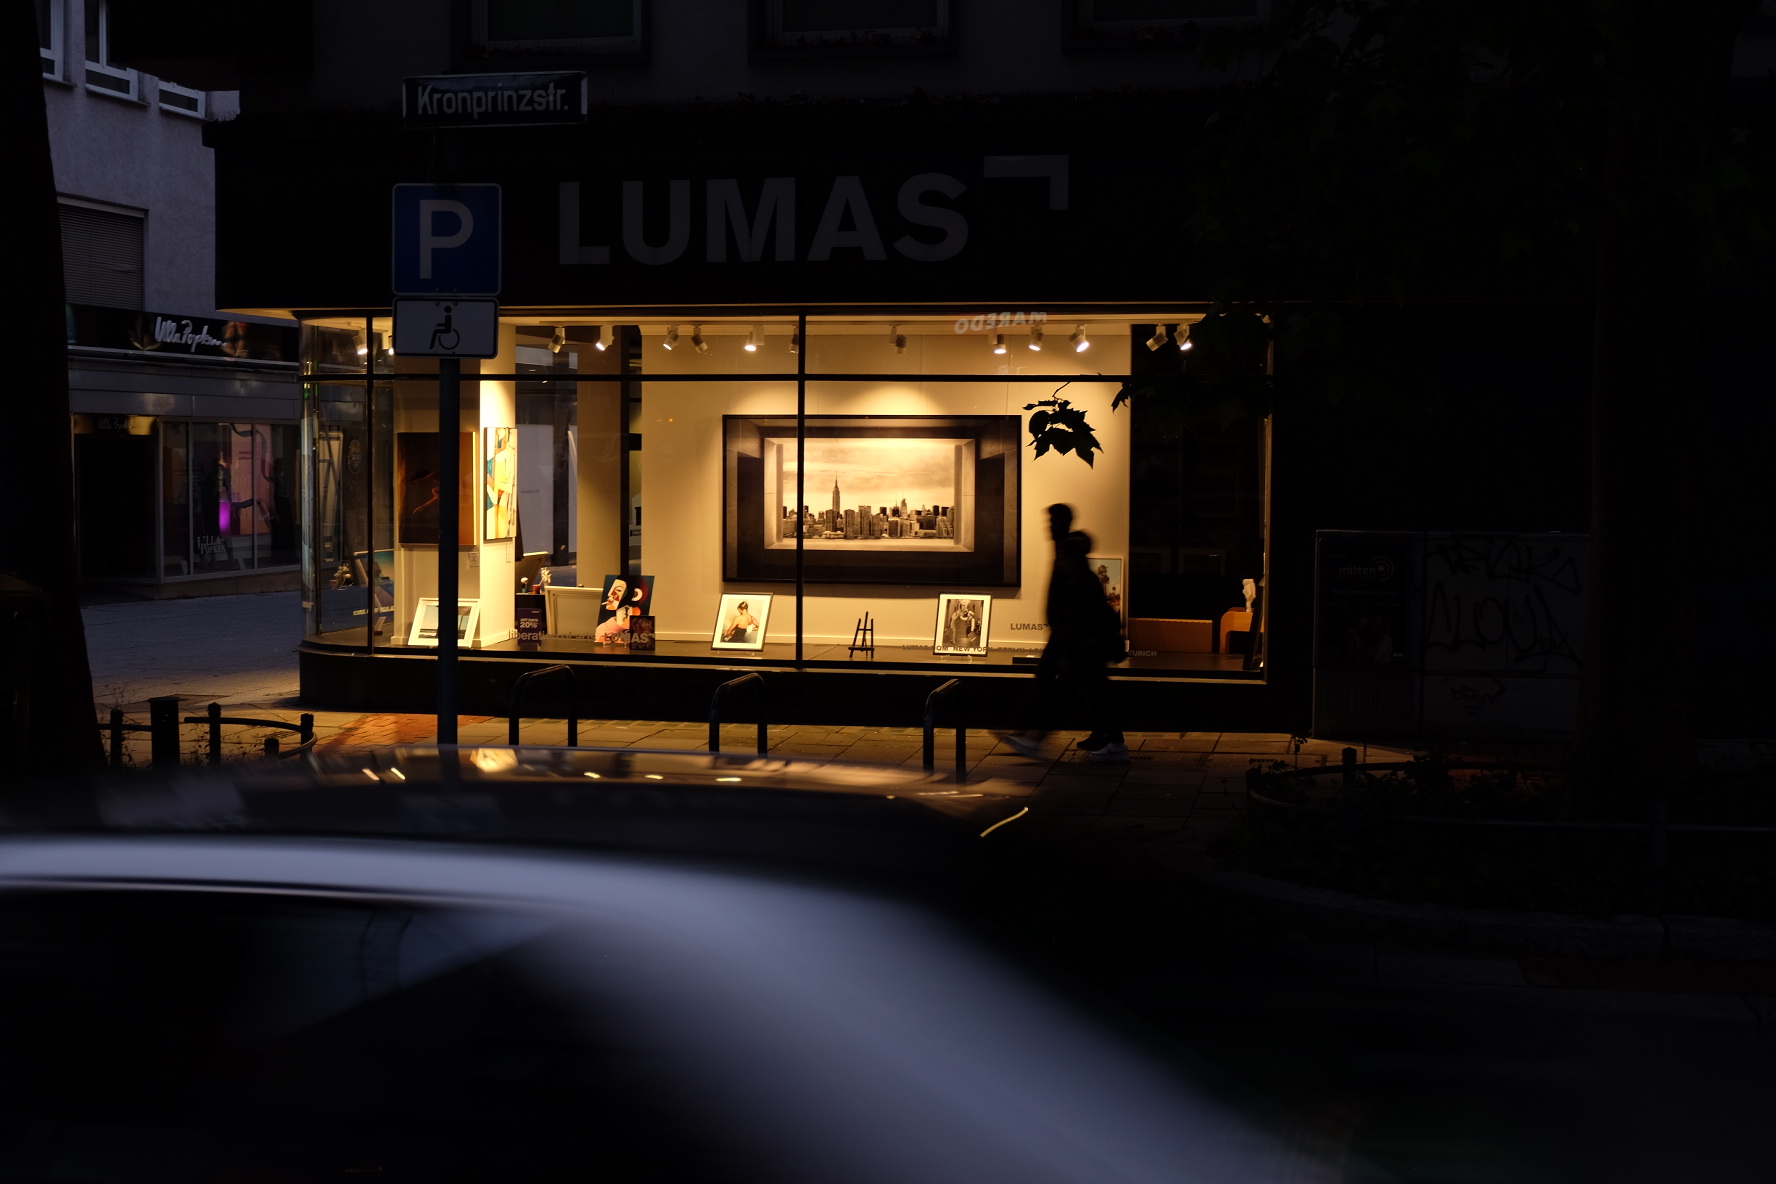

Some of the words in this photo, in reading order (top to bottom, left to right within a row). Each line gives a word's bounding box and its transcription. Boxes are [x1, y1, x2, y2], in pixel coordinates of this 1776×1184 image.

[417, 82, 569, 120] Kronprinzstr.
[558, 172, 970, 266] LUMAS
[419, 199, 474, 280] P
[519, 621, 538, 629] 20%
[1010, 623, 1043, 631] LUMAS
